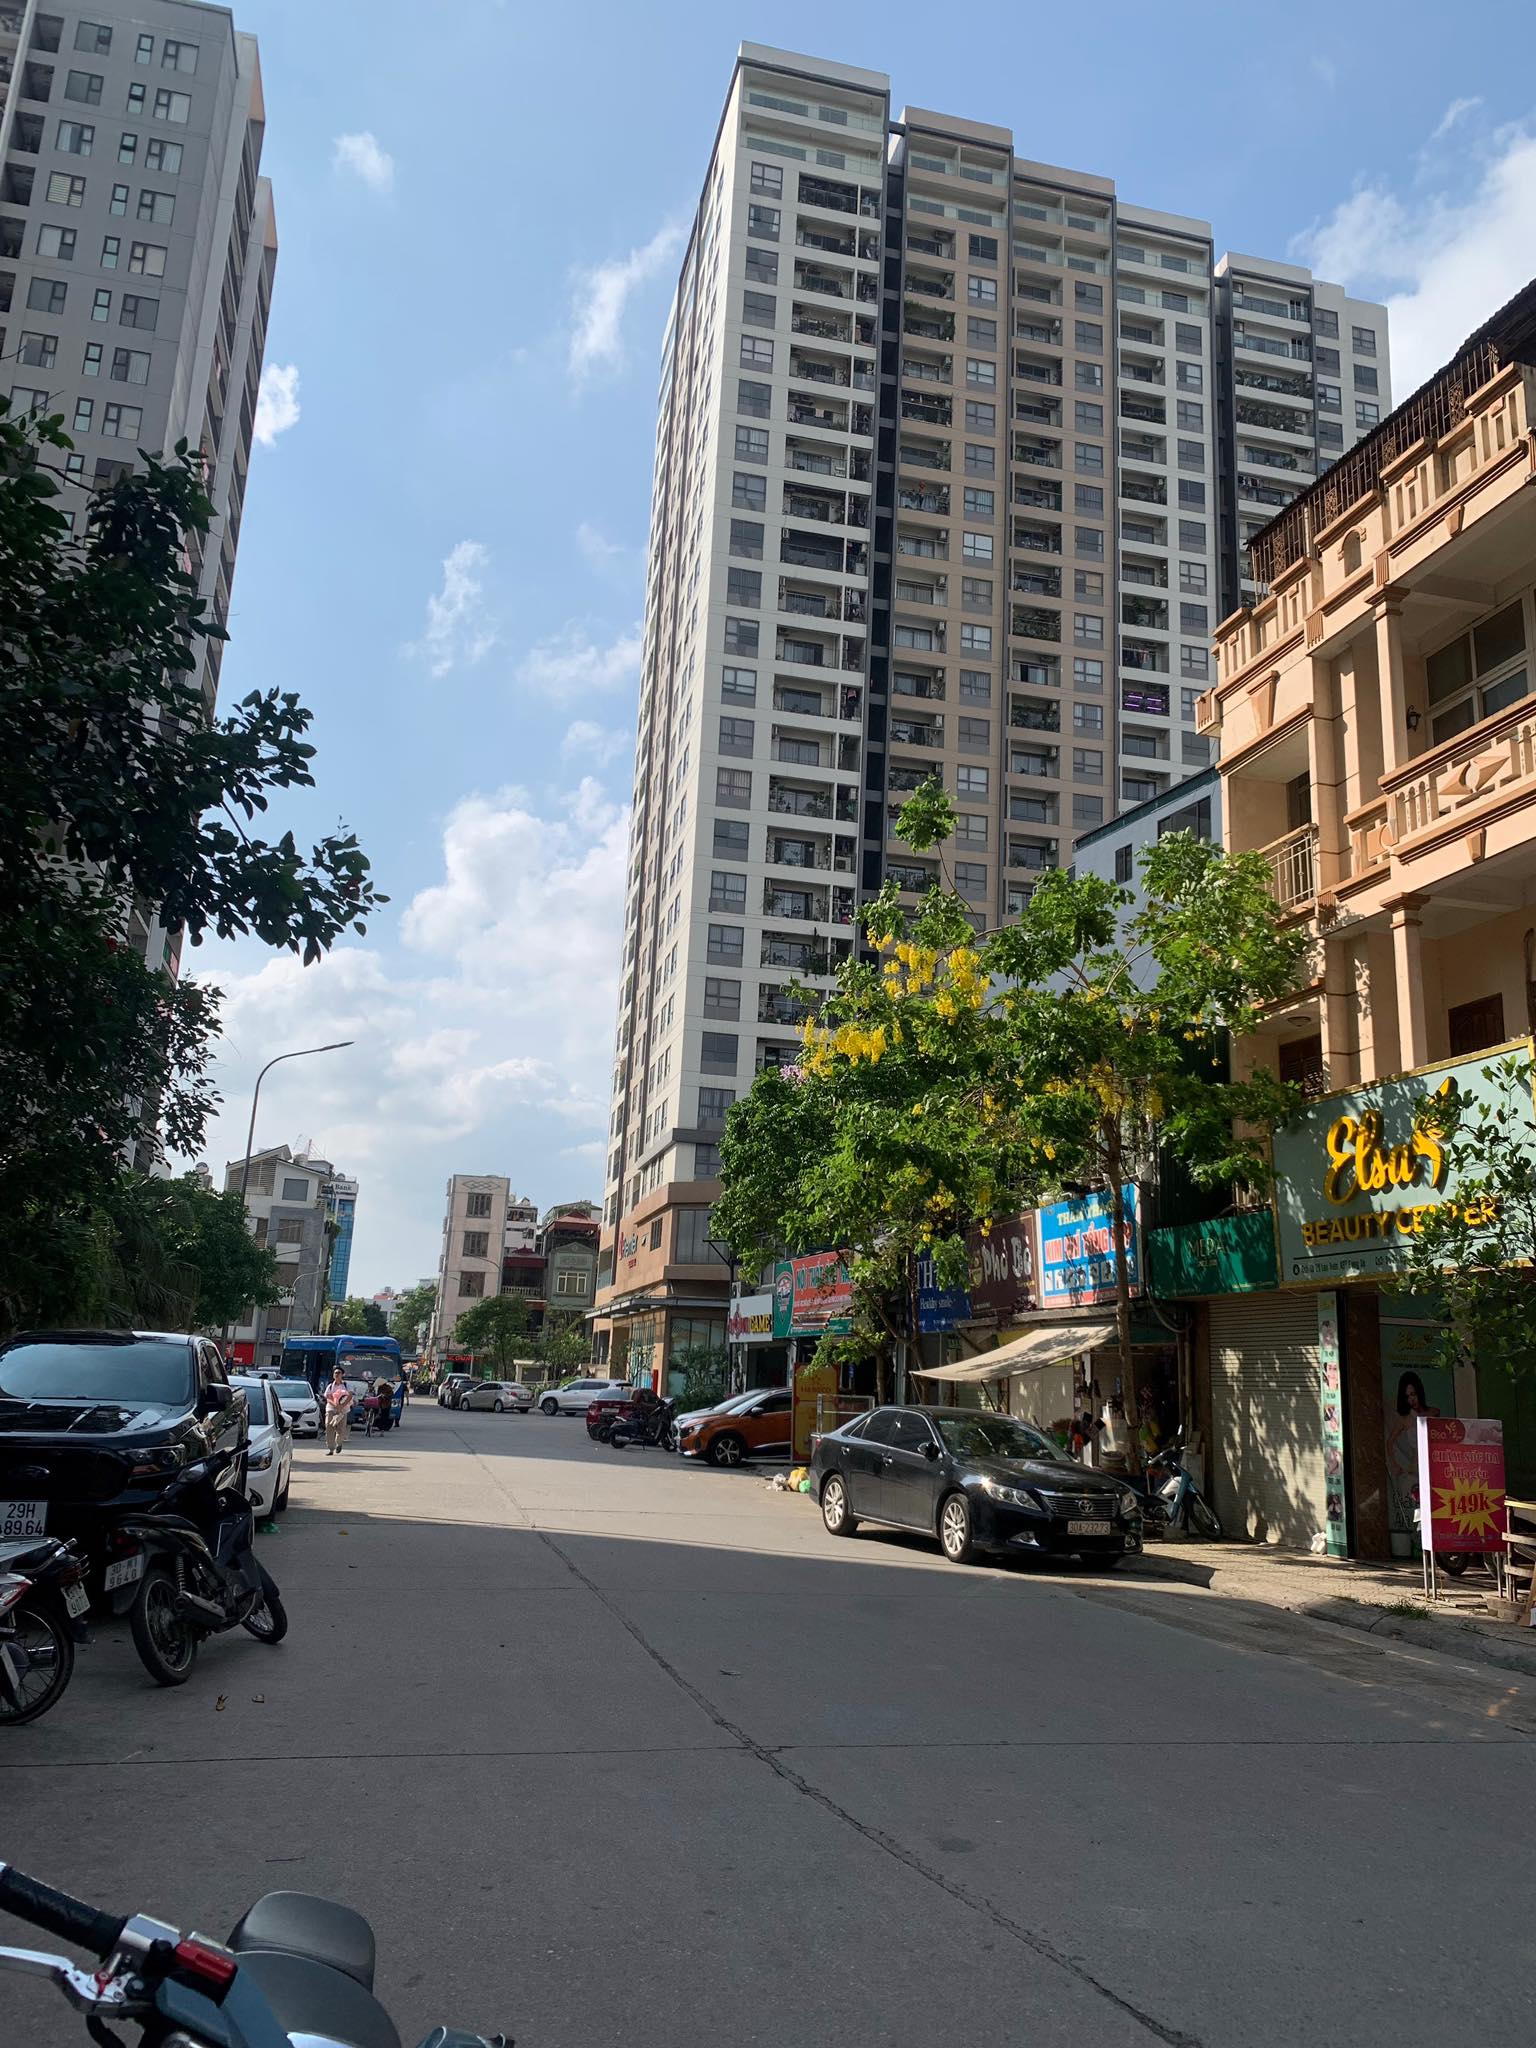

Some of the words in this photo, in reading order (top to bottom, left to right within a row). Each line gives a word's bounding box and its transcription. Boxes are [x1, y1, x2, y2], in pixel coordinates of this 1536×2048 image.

[1324, 1109, 1413, 1205] Elsa
[1303, 1211, 1393, 1247] BEAUTY
[7, 1503, 36, 1519] 29H
[1450, 1492, 1490, 1516] 149k
